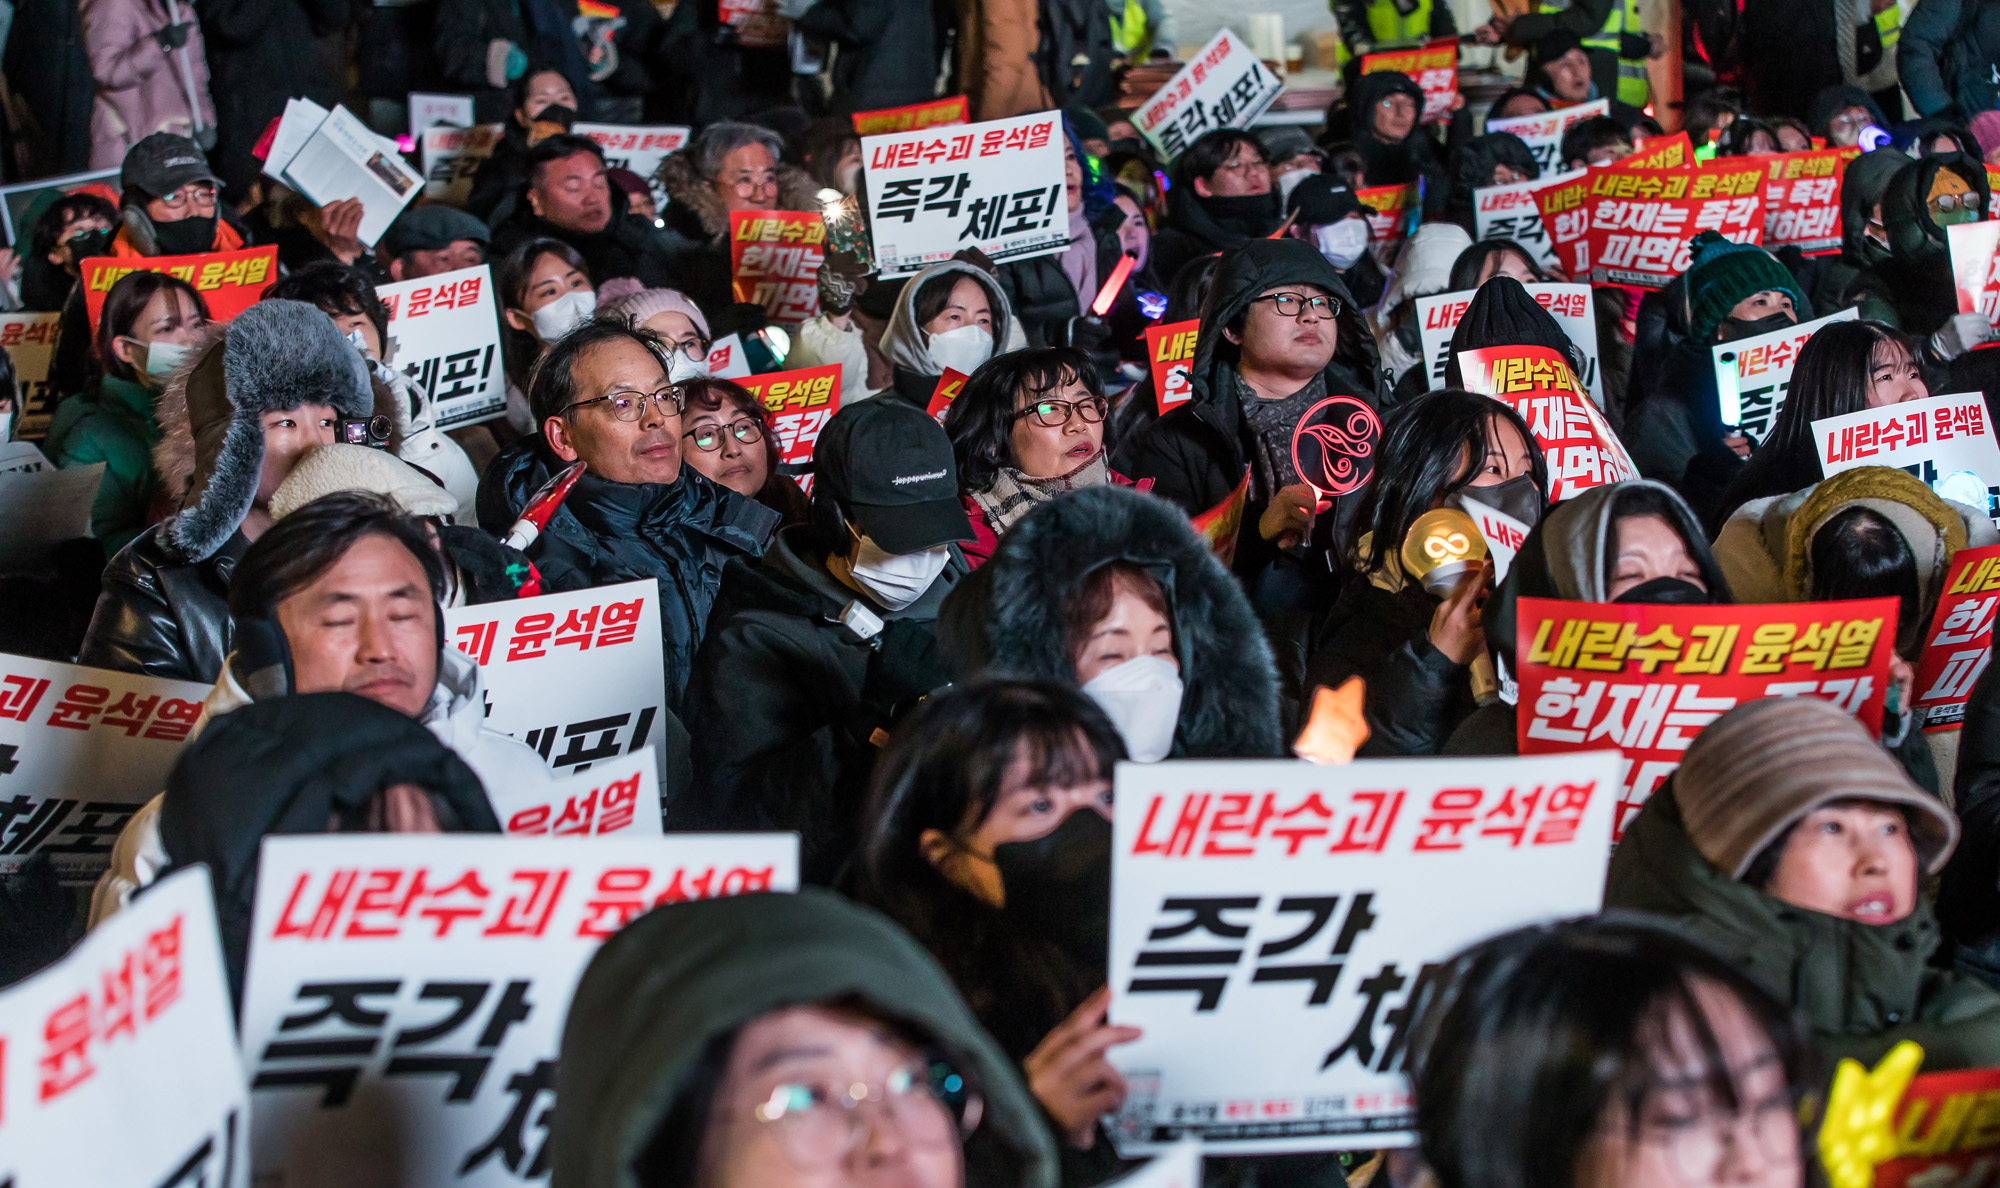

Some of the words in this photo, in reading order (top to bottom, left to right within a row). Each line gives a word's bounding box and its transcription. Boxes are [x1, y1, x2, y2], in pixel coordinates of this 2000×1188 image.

[1211, 63, 1264, 127] 체포!
[870, 134, 975, 171] 내란수괴
[979, 121, 1053, 158] 윤석열
[1785, 156, 1837, 180] 윤석열
[876, 172, 971, 224] 즉각
[958, 183, 1062, 243] 체포!
[1543, 184, 1588, 215] 내란
[1591, 174, 1690, 200] 내란수괴
[1690, 169, 1763, 199] 윤석열
[1789, 177, 1837, 207] 즉각
[736, 218, 827, 245] 내란수괴
[1591, 200, 1690, 234] 헌재는
[1694, 195, 1760, 232] 즉각
[197, 255, 271, 292] 윤석열
[738, 245, 825, 280] 헌재는
[407, 276, 482, 319] 윤석열
[751, 282, 821, 319] 파면
[764, 374, 836, 412] 윤석열
[1474, 357, 1574, 397] 내란수괴
[773, 407, 833, 454] 즉각
[1503, 395, 1593, 441] 재는
[1827, 411, 1928, 465] 내란수괴
[1934, 403, 1985, 441] 윤석열
[506, 597, 645, 663] 윤석열
[1526, 618, 1741, 674] 내란수괴
[1739, 616, 1885, 675] 윤석열
[46, 683, 203, 742] 윤석열
[1527, 676, 1738, 751] 헌재는
[1130, 788, 1409, 861] 내란수괴
[1411, 777, 1598, 854] 윤석열
[271, 866, 571, 941] 내란수괴
[1126, 889, 1379, 1014] 즉각
[38, 912, 184, 1107] 윤석열
[249, 979, 536, 1108] 즉각
